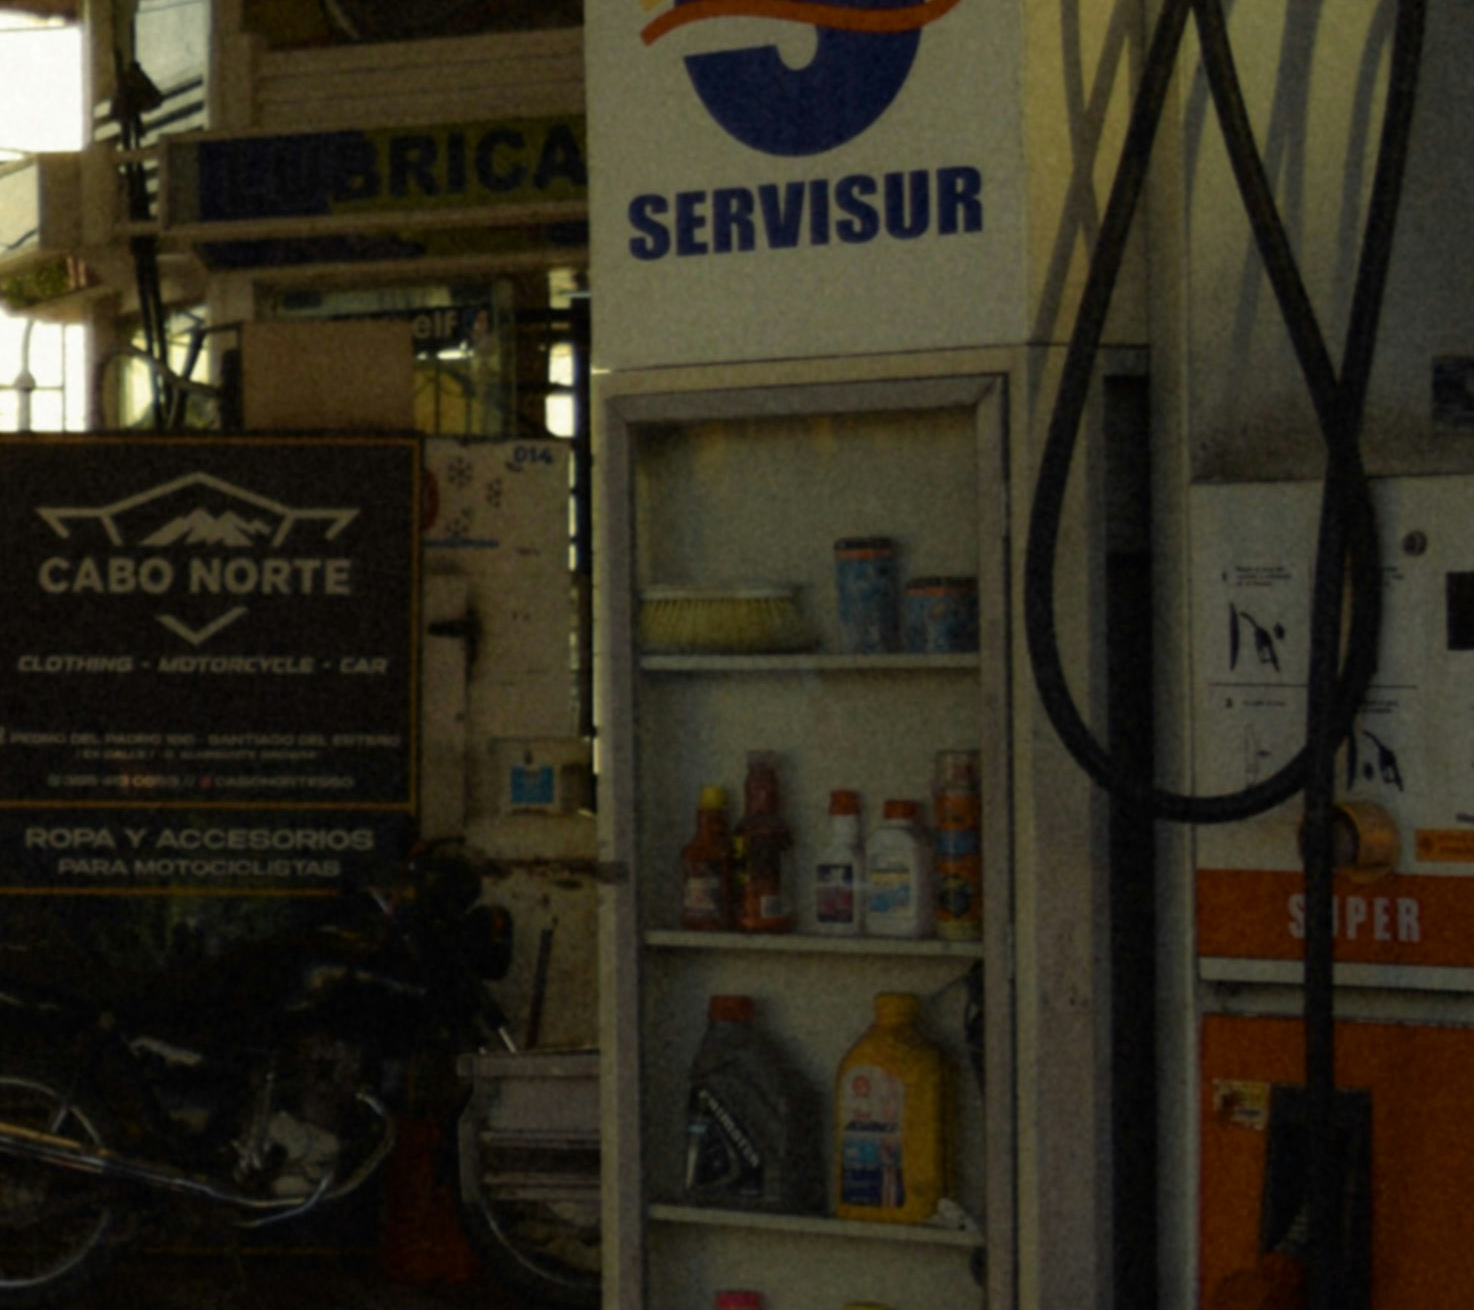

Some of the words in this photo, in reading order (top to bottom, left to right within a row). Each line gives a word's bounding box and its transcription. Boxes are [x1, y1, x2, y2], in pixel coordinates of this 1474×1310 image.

[627, 164, 983, 262] SERVISUR
[37, 556, 175, 596] CABO
[189, 557, 352, 596] NORTE
[16, 655, 134, 674] CLOTHING
[157, 656, 313, 674] MOTORCYCLE
[338, 656, 388, 674] CAR
[24, 826, 116, 850] ROPA
[123, 827, 149, 850] Y
[155, 827, 376, 852] ACCESORIOS
[57, 857, 129, 877] PARA
[134, 858, 341, 878] MOTOCICLISTAS
